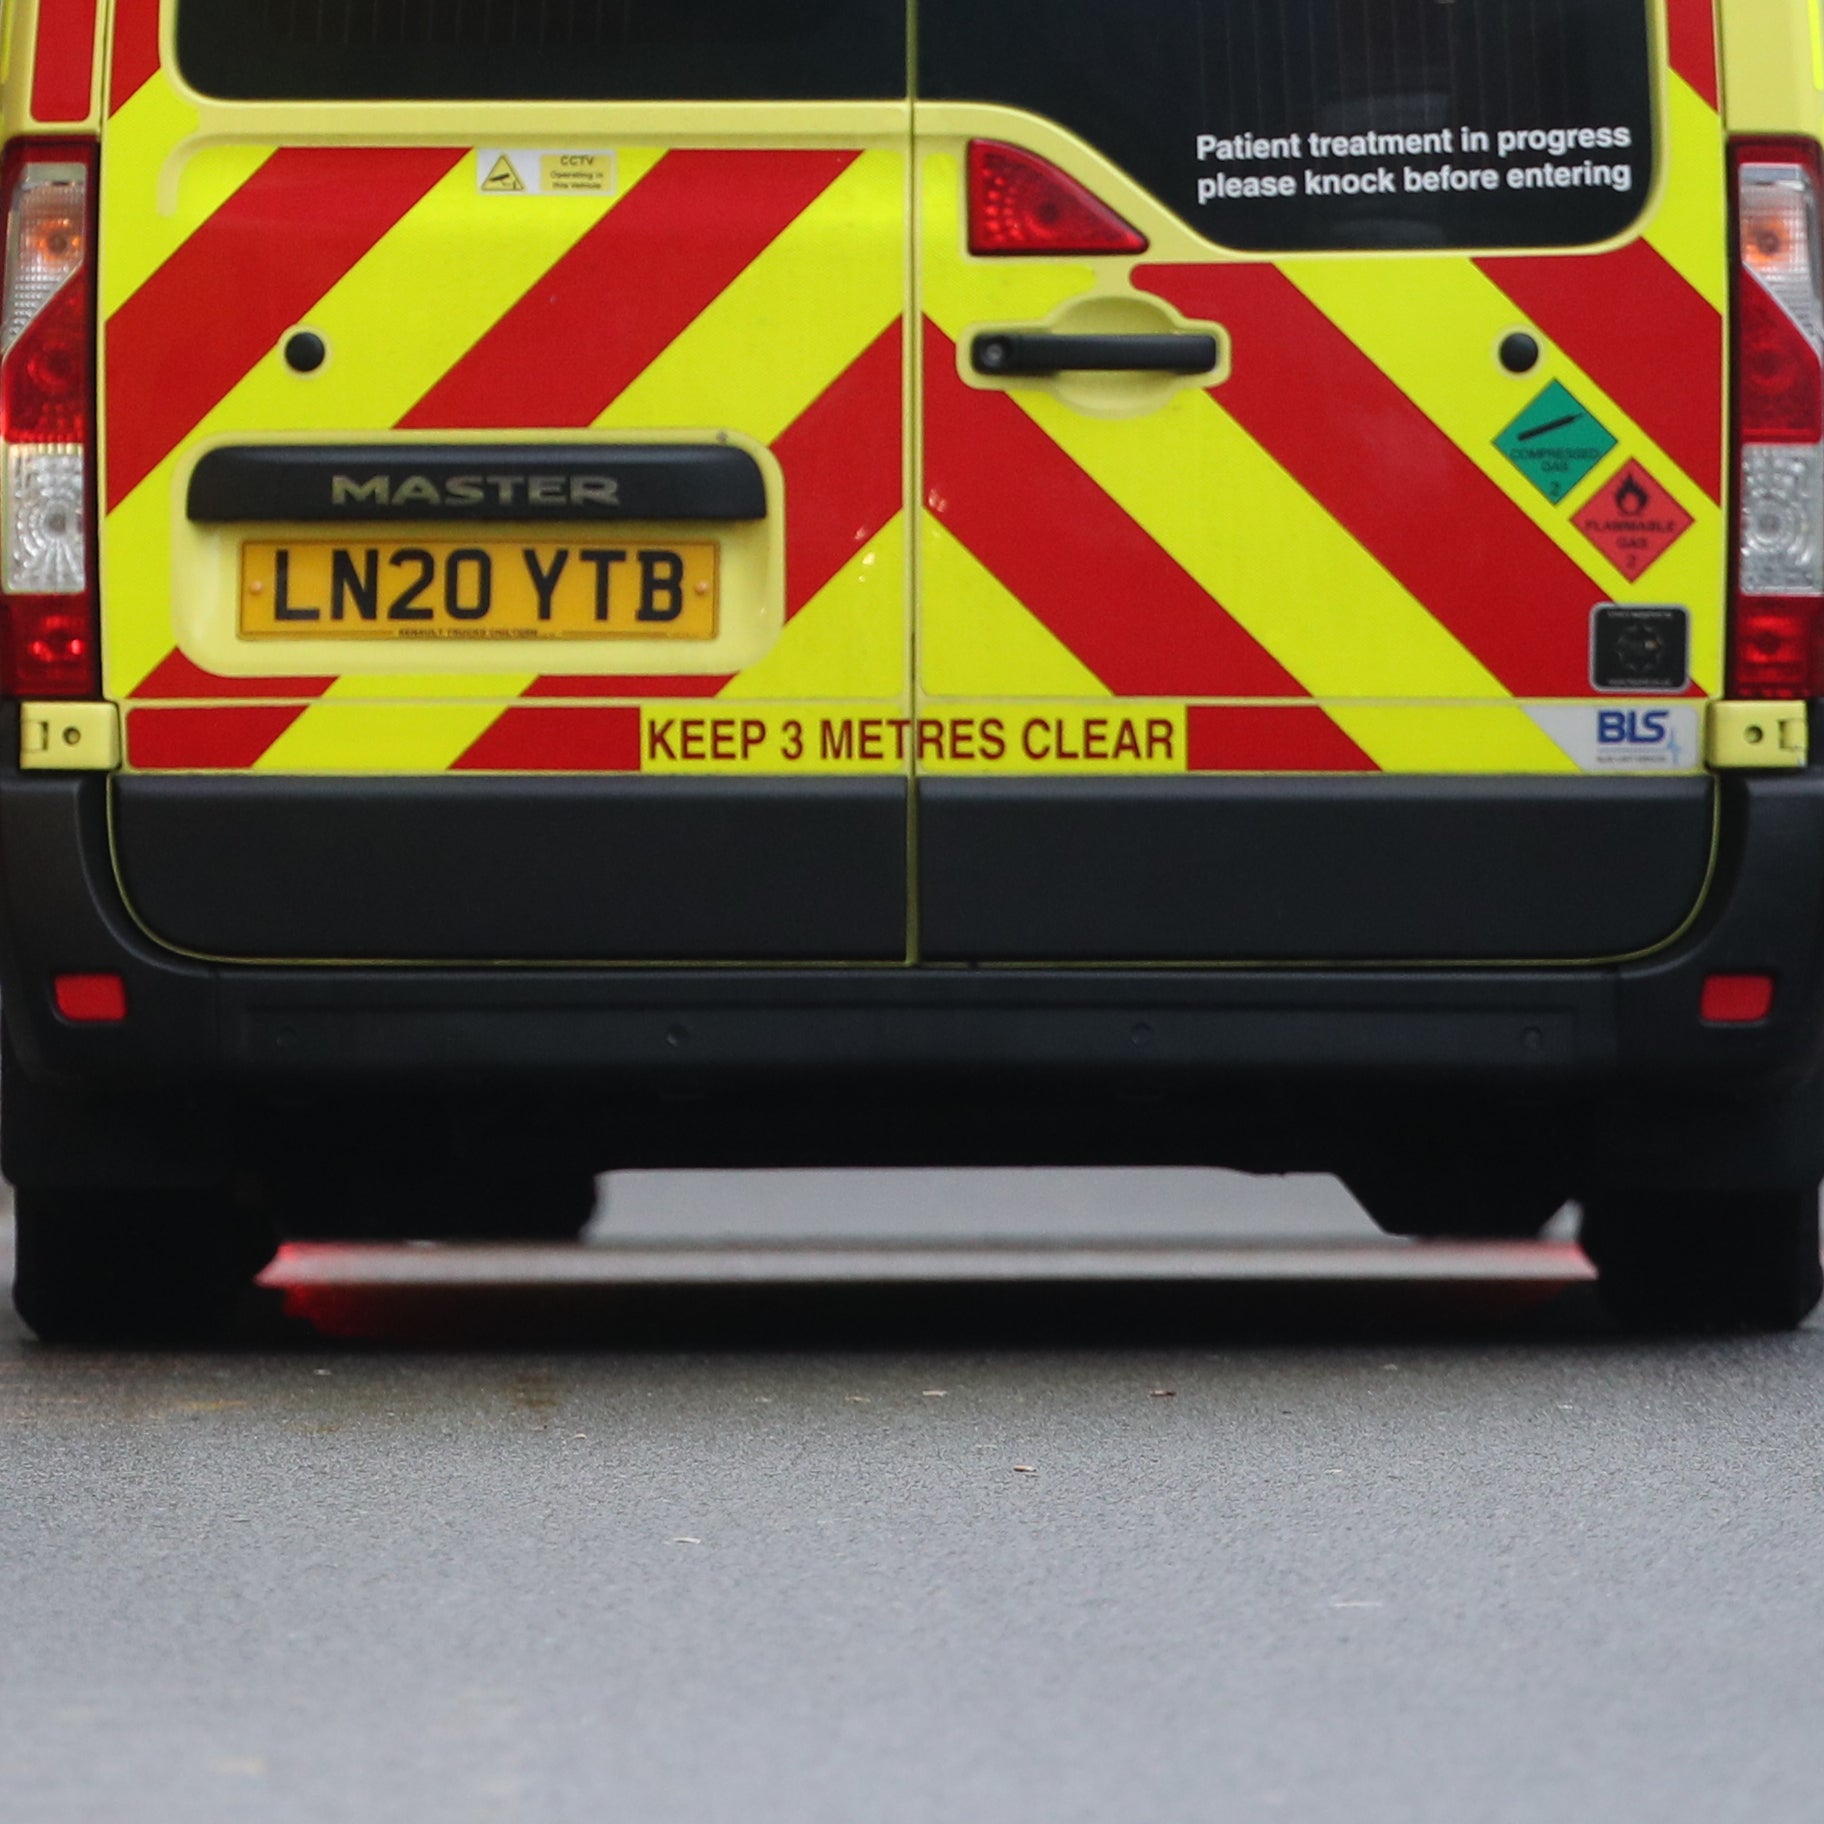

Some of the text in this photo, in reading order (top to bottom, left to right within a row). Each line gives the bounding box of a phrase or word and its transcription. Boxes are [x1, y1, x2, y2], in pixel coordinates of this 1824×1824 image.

[1196, 124, 1632, 162] Patient treatment in progress
[560, 155, 594, 166] CCTV
[1197, 160, 1632, 204] please knock before entering
[1509, 448, 1601, 460] COMPRESSED
[1541, 461, 1569, 472] GAS
[332, 475, 620, 506] MASTER
[1584, 520, 1675, 532] FLAMMABLE
[1617, 537, 1647, 549] GAS
[275, 548, 684, 621] LN20 YTB
[648, 718, 1174, 760] KEEP 3 METRES CLEAR
[1597, 710, 1669, 743] BLS
